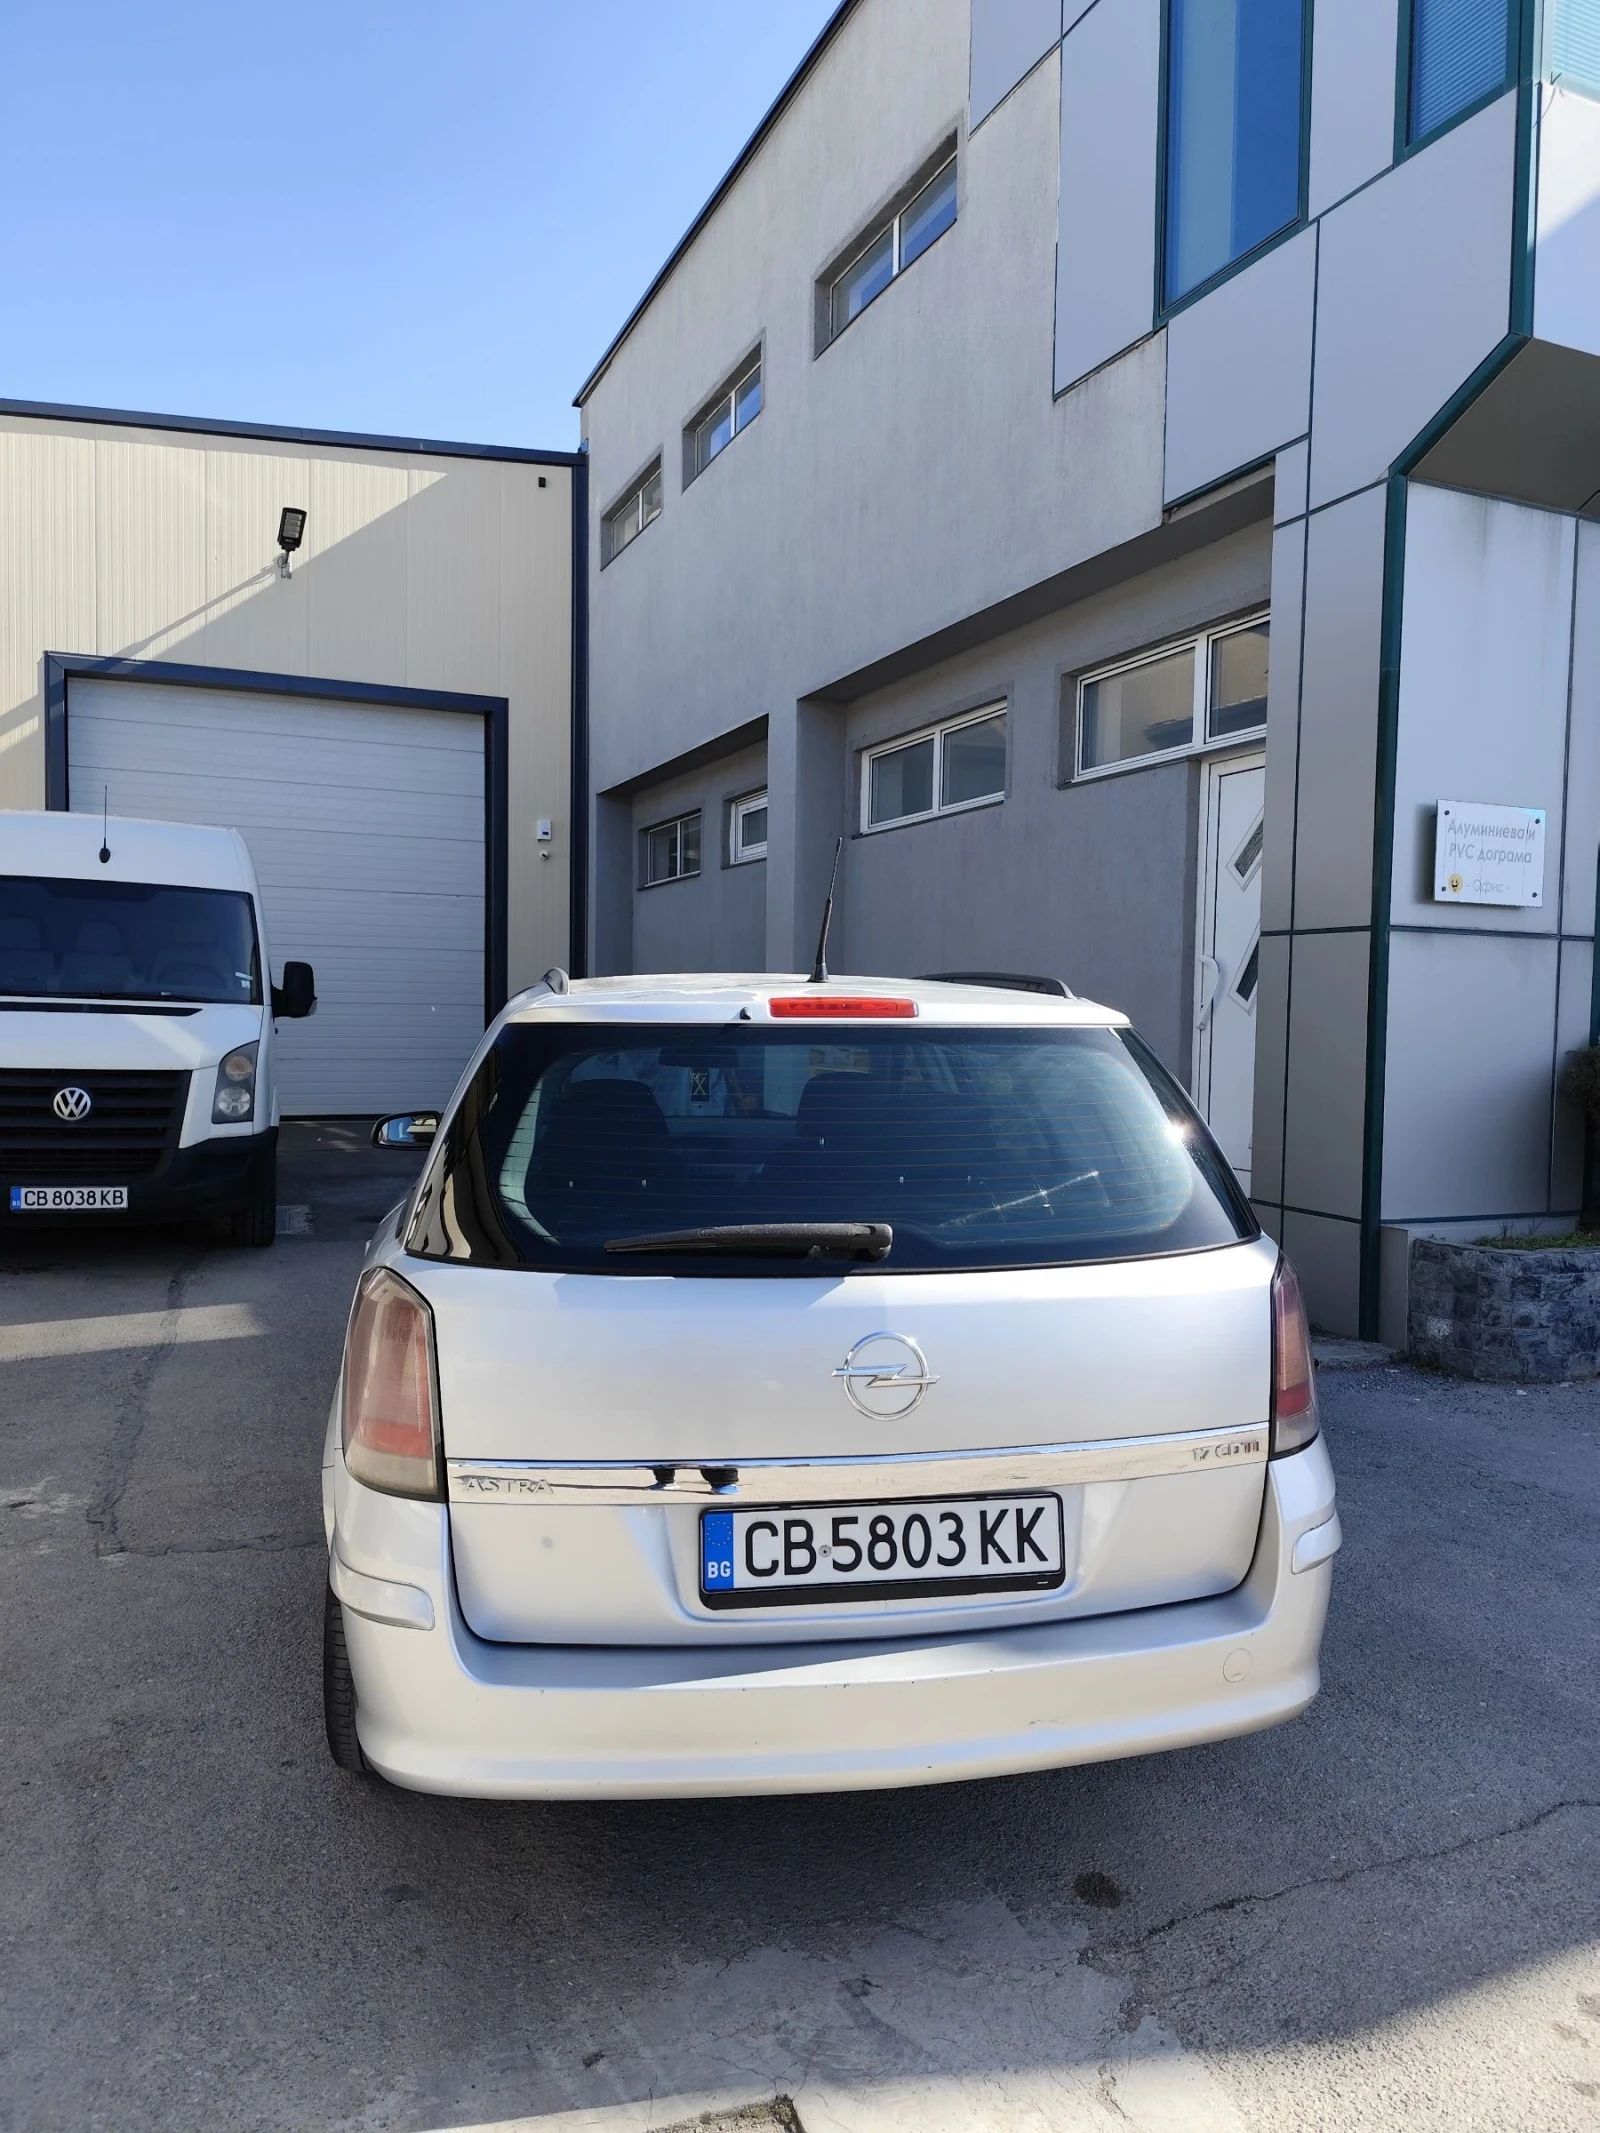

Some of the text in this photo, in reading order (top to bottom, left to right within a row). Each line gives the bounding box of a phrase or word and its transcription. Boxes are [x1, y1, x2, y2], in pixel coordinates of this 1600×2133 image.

[1447, 818, 1536, 841] Алуминиева и
[1449, 842, 1532, 865] PVC дограма
[53, 1087, 91, 1120] VW
[24, 1190, 48, 1206] CB
[52, 1190, 97, 1206] 8038
[100, 1189, 124, 1206] KB
[463, 1477, 554, 1494] ASTRA
[707, 1506, 1049, 1578] BG CB 5803 KK
